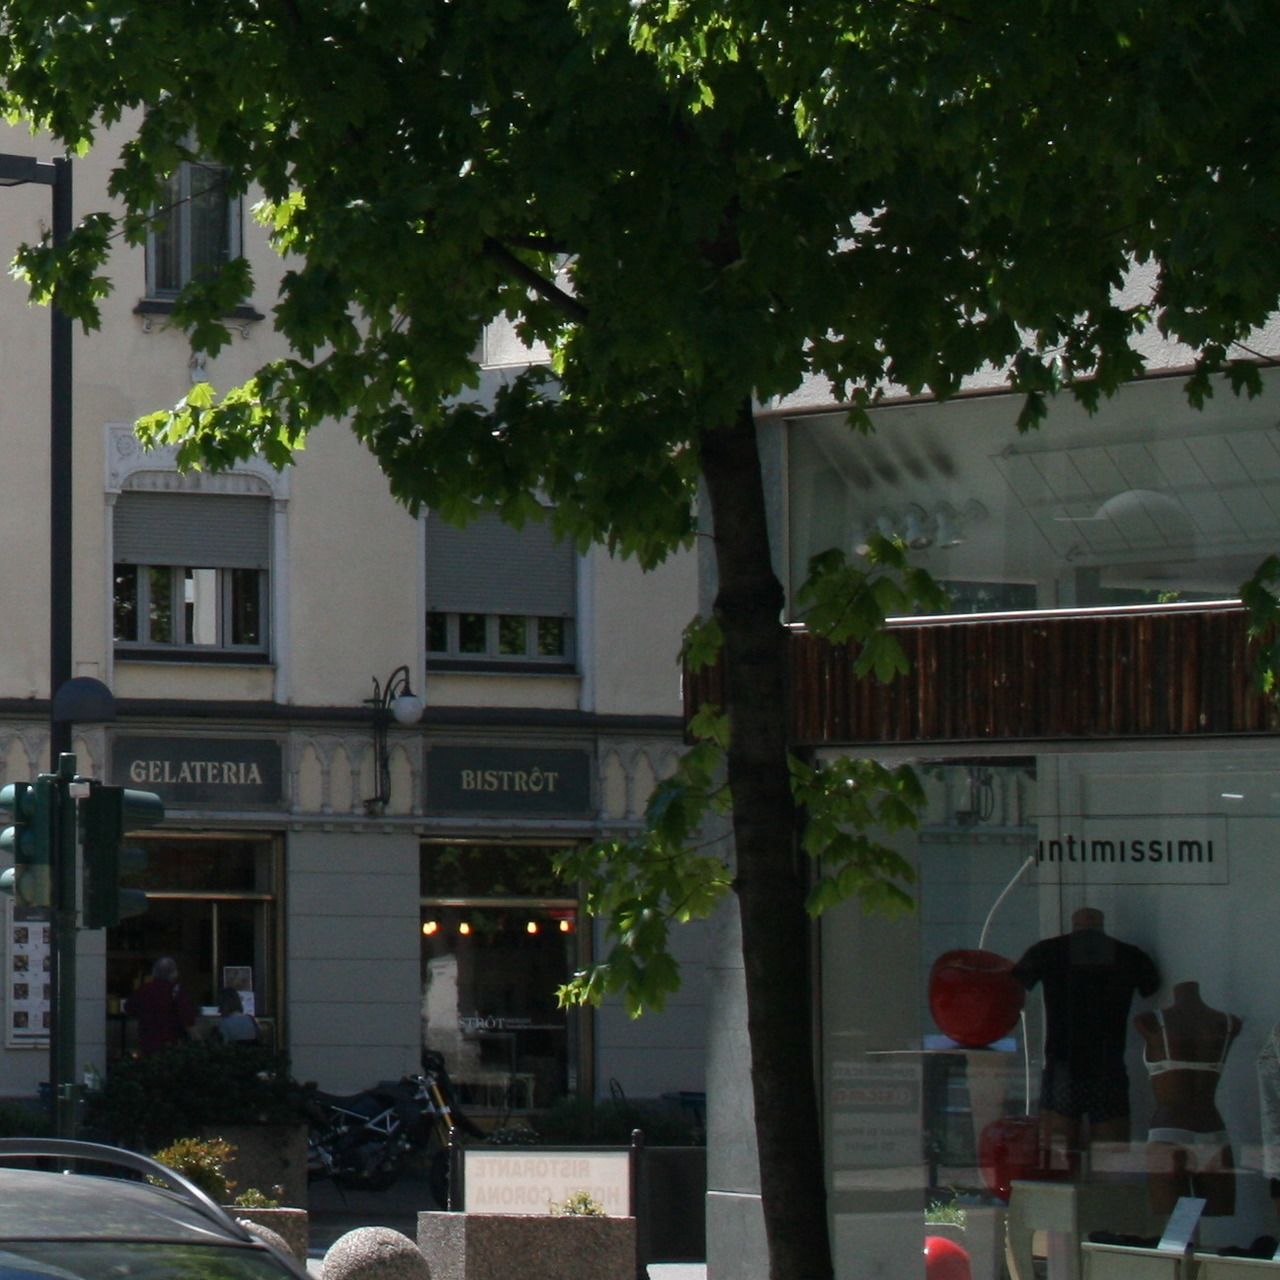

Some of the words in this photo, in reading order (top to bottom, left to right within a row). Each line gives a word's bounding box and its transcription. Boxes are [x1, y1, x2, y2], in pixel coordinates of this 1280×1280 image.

[129, 759, 263, 785] GELATERIA
[460, 765, 559, 793] BISTRÔT
[1039, 834, 1213, 863] intimissimi
